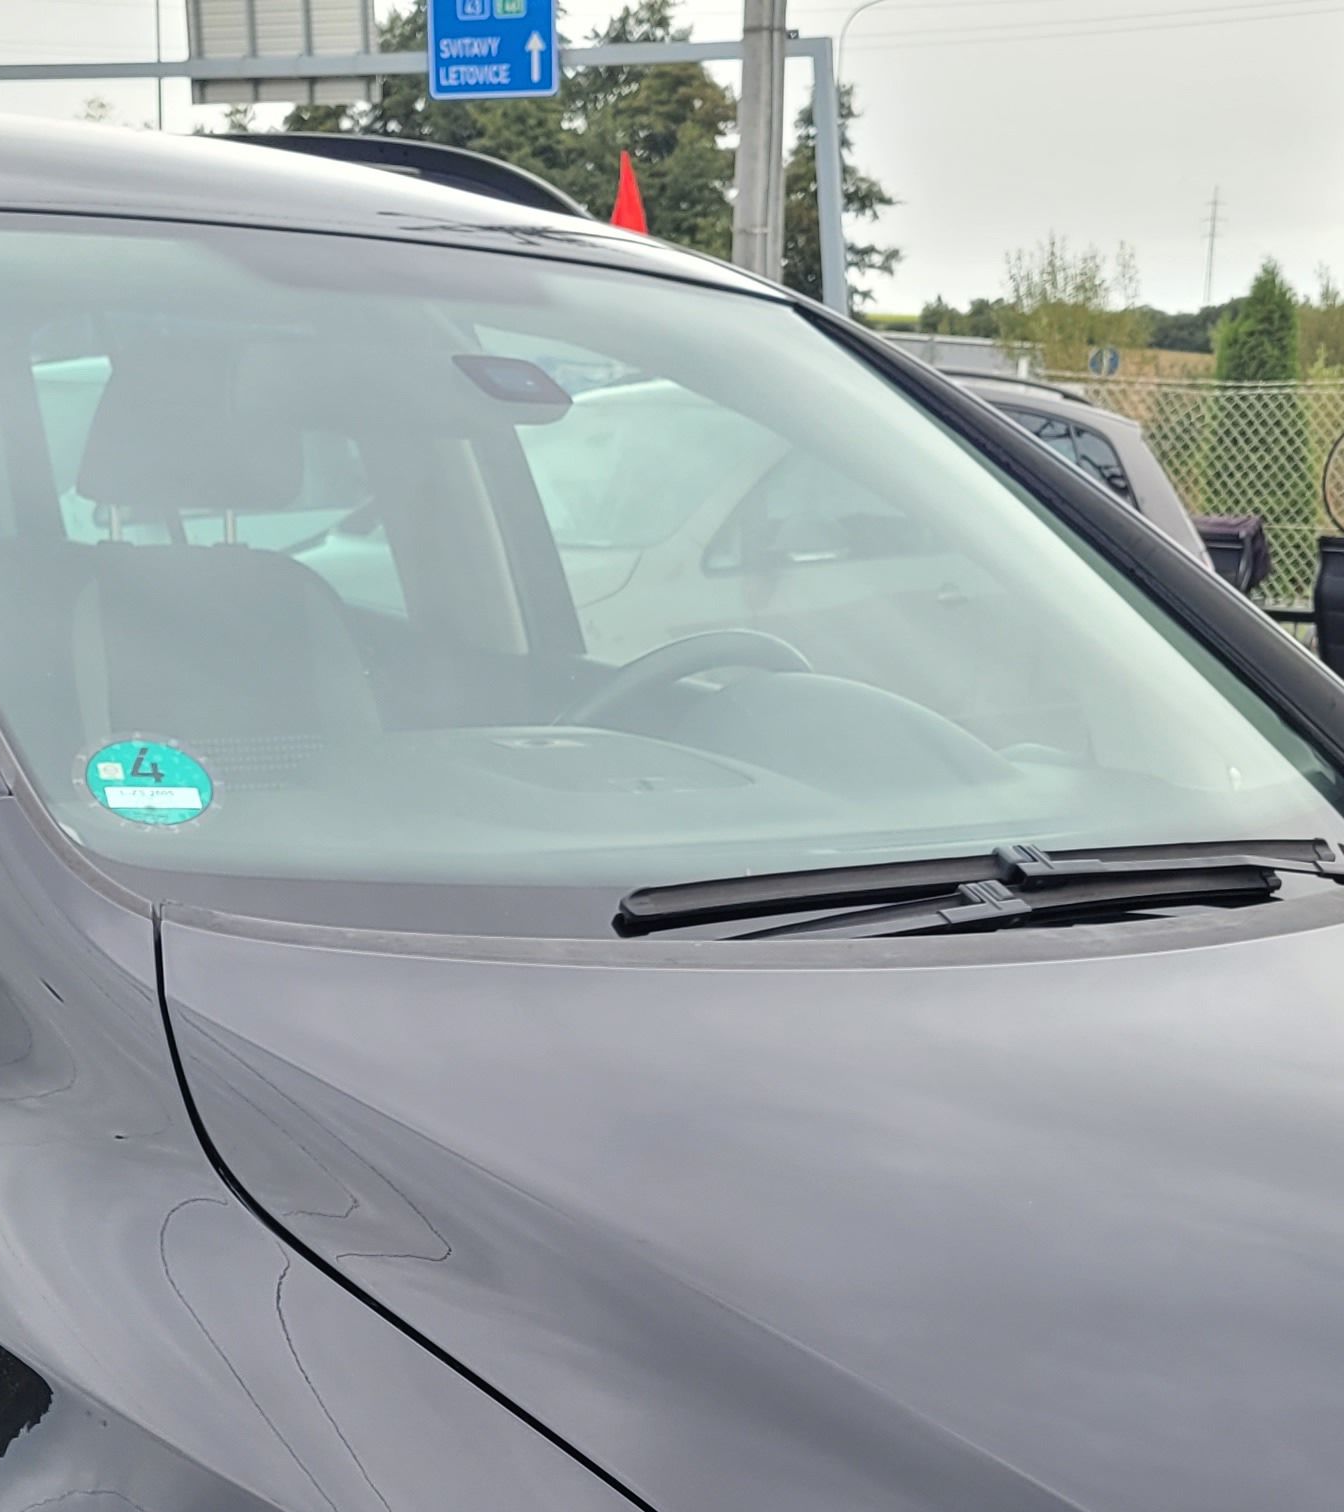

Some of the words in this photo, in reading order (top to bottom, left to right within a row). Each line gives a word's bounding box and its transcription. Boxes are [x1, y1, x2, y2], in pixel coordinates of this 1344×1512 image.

[440, 37, 500, 58] SVITAVY
[440, 64, 510, 86] LETOVICE
[130, 747, 165, 783] 4
